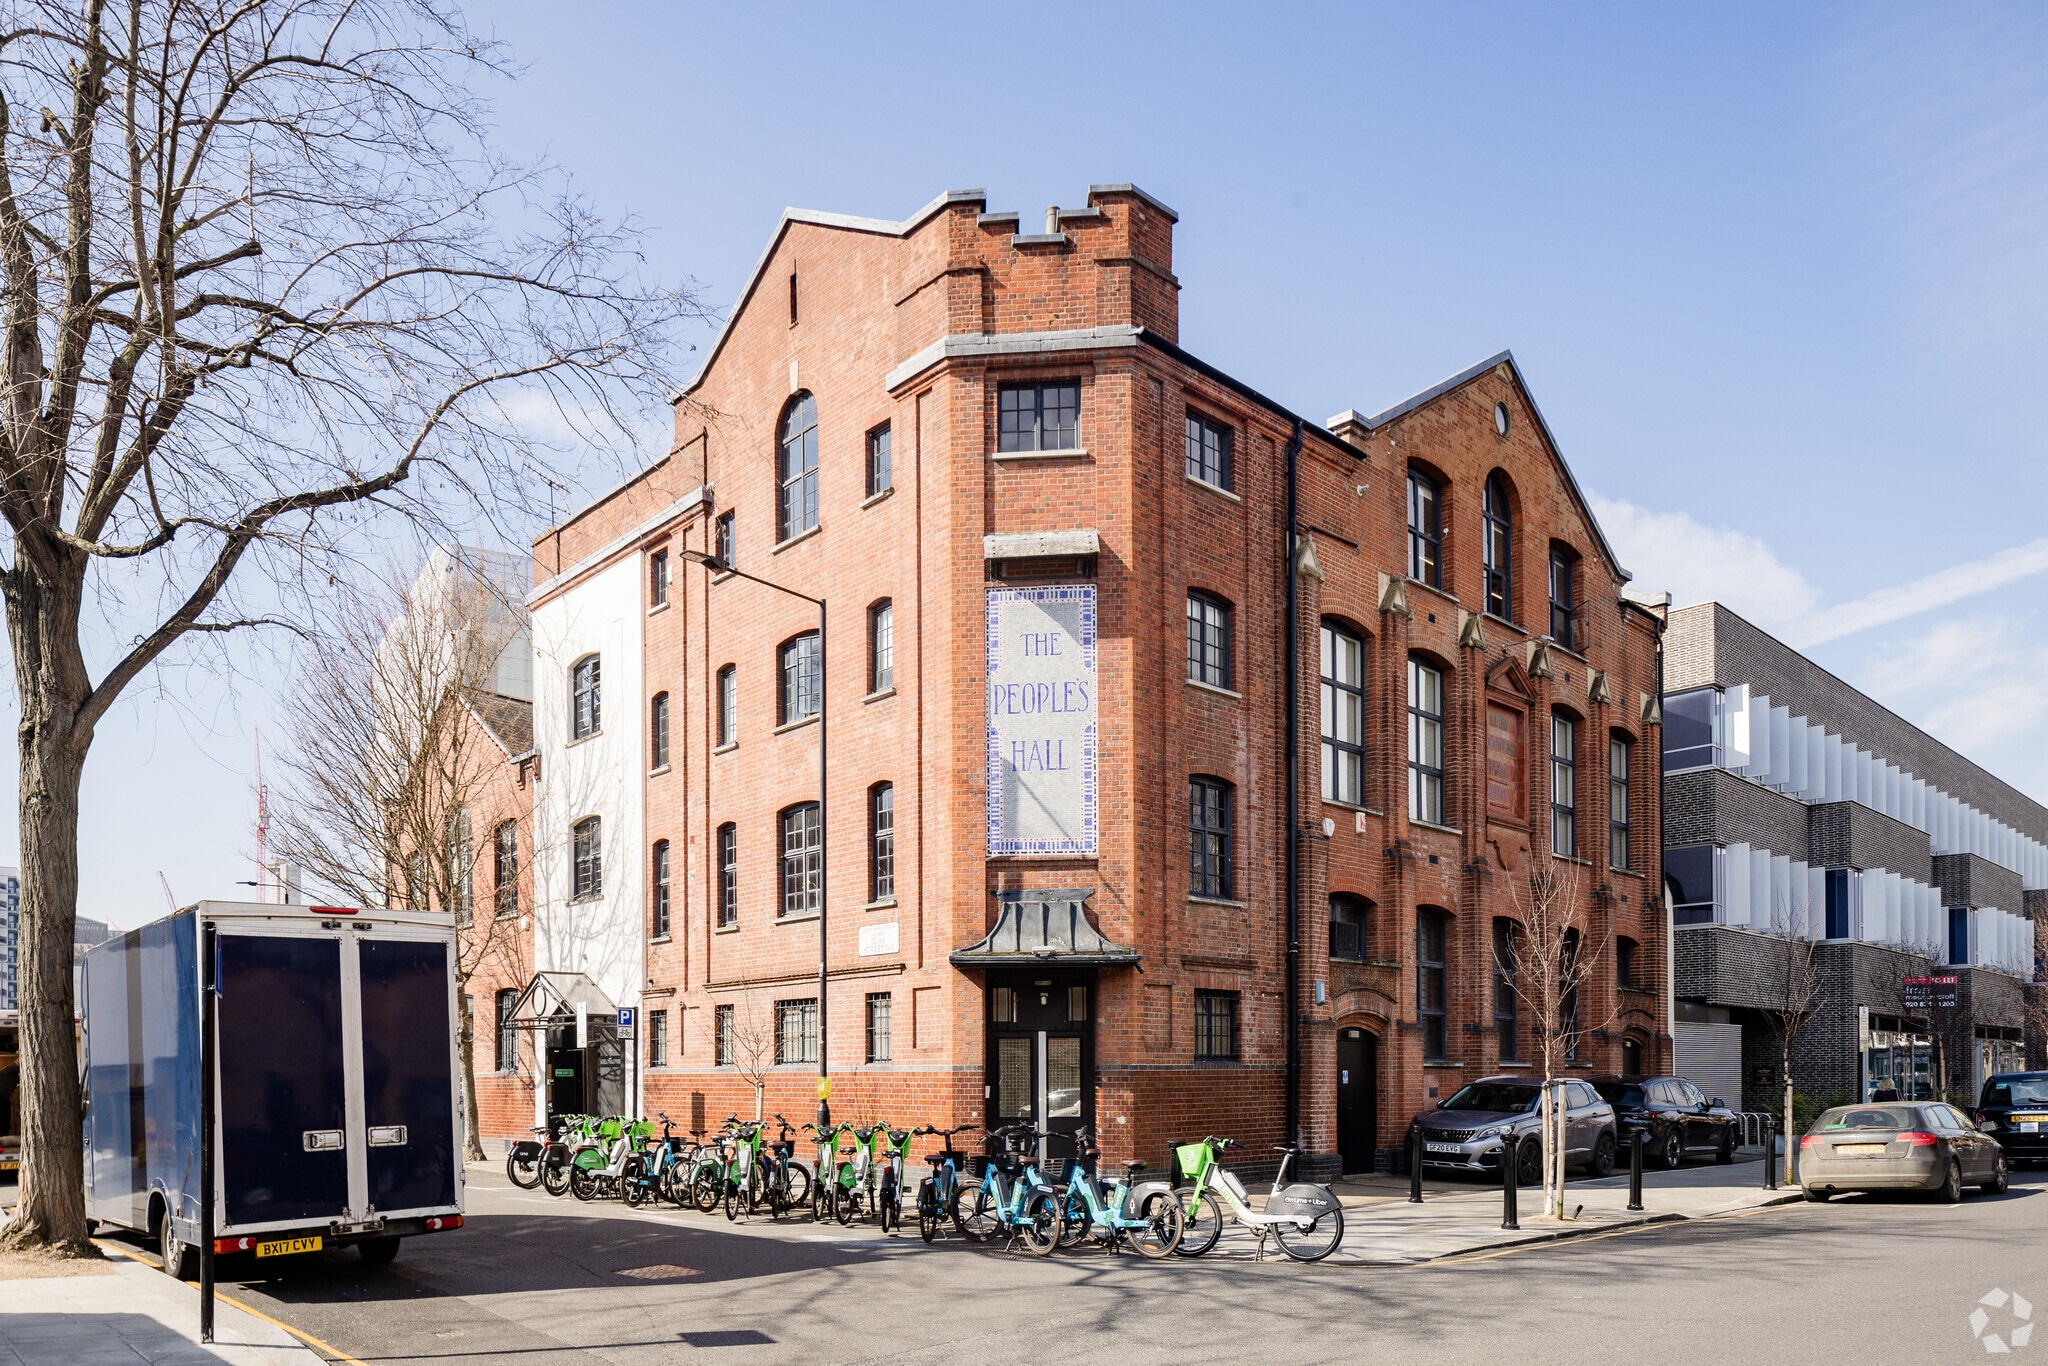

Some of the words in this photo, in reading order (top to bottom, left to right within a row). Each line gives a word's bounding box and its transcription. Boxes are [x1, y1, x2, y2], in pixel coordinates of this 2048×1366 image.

[1019, 632, 1063, 657] THE
[993, 678, 1090, 715] PEOPLE'S
[1011, 739, 1071, 772] HALL
[620, 1010, 630, 1024] P
[1219, 1184, 1241, 1211] Lime
[263, 1241, 290, 1255] BX17
[293, 1237, 316, 1251] CVY
